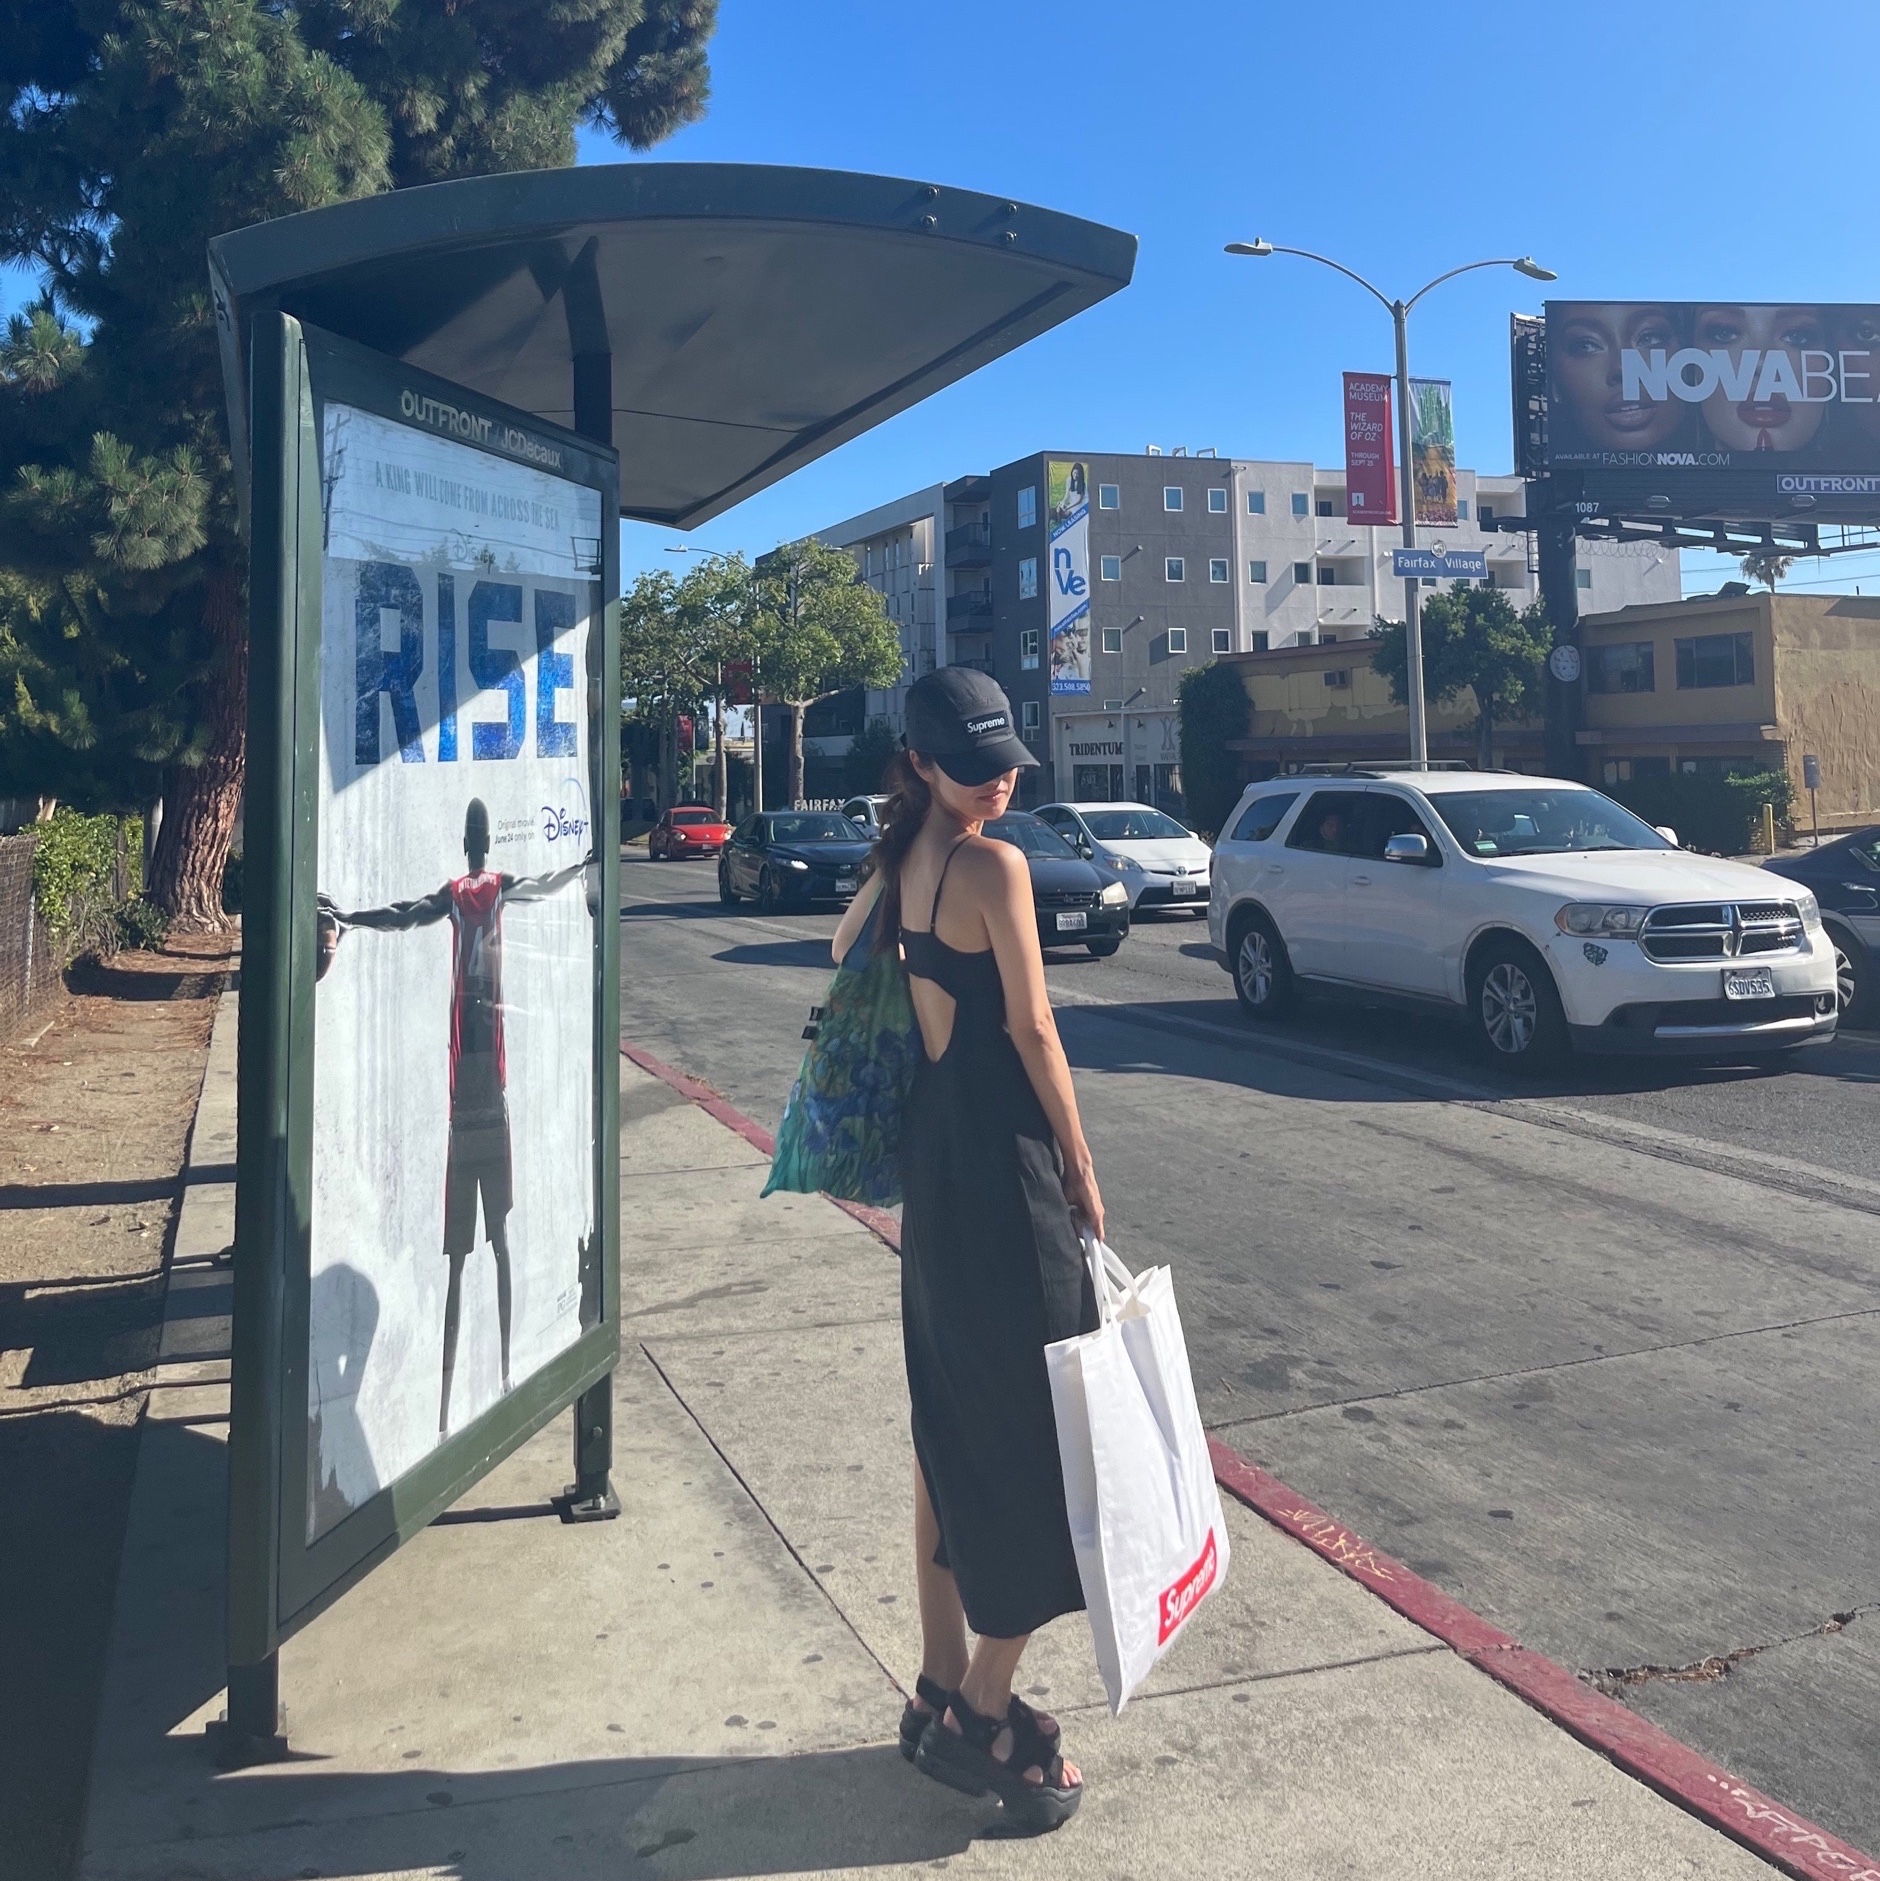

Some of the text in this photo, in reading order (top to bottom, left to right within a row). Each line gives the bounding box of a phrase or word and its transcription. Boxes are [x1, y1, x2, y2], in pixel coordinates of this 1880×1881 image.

[1621, 347, 1880, 403] NOVABE
[1348, 382, 1389, 393] ACADEMY
[1349, 392, 1388, 403] MUSEUM
[1350, 412, 1367, 421] THE
[1350, 422, 1383, 432] WIZARD
[1350, 432, 1377, 441] OF OZ
[501, 426, 562, 469] JCDecaux
[1350, 451, 1380, 460] THROUGH
[1592, 452, 1601, 460] AT
[1602, 452, 1730, 466] FASHIONNOVA.COM
[1781, 477, 1880, 491] OUTFRONT
[375, 460, 560, 531] A KING WILL COME FROM ACROSS THE SEA
[1575, 502, 1599, 513] 1087
[1065, 508, 1087, 528] LEASING
[1398, 556, 1482, 572] Fairfax Village
[355, 559, 578, 765] RISE
[967, 717, 1005, 733] Supreme
[1069, 741, 1124, 756] TRIDENTUM
[794, 798, 846, 812] FAIRFAX
[498, 819, 516, 831] Original
[494, 834, 508, 844] June
[1165, 1546, 1215, 1628] Supreme
